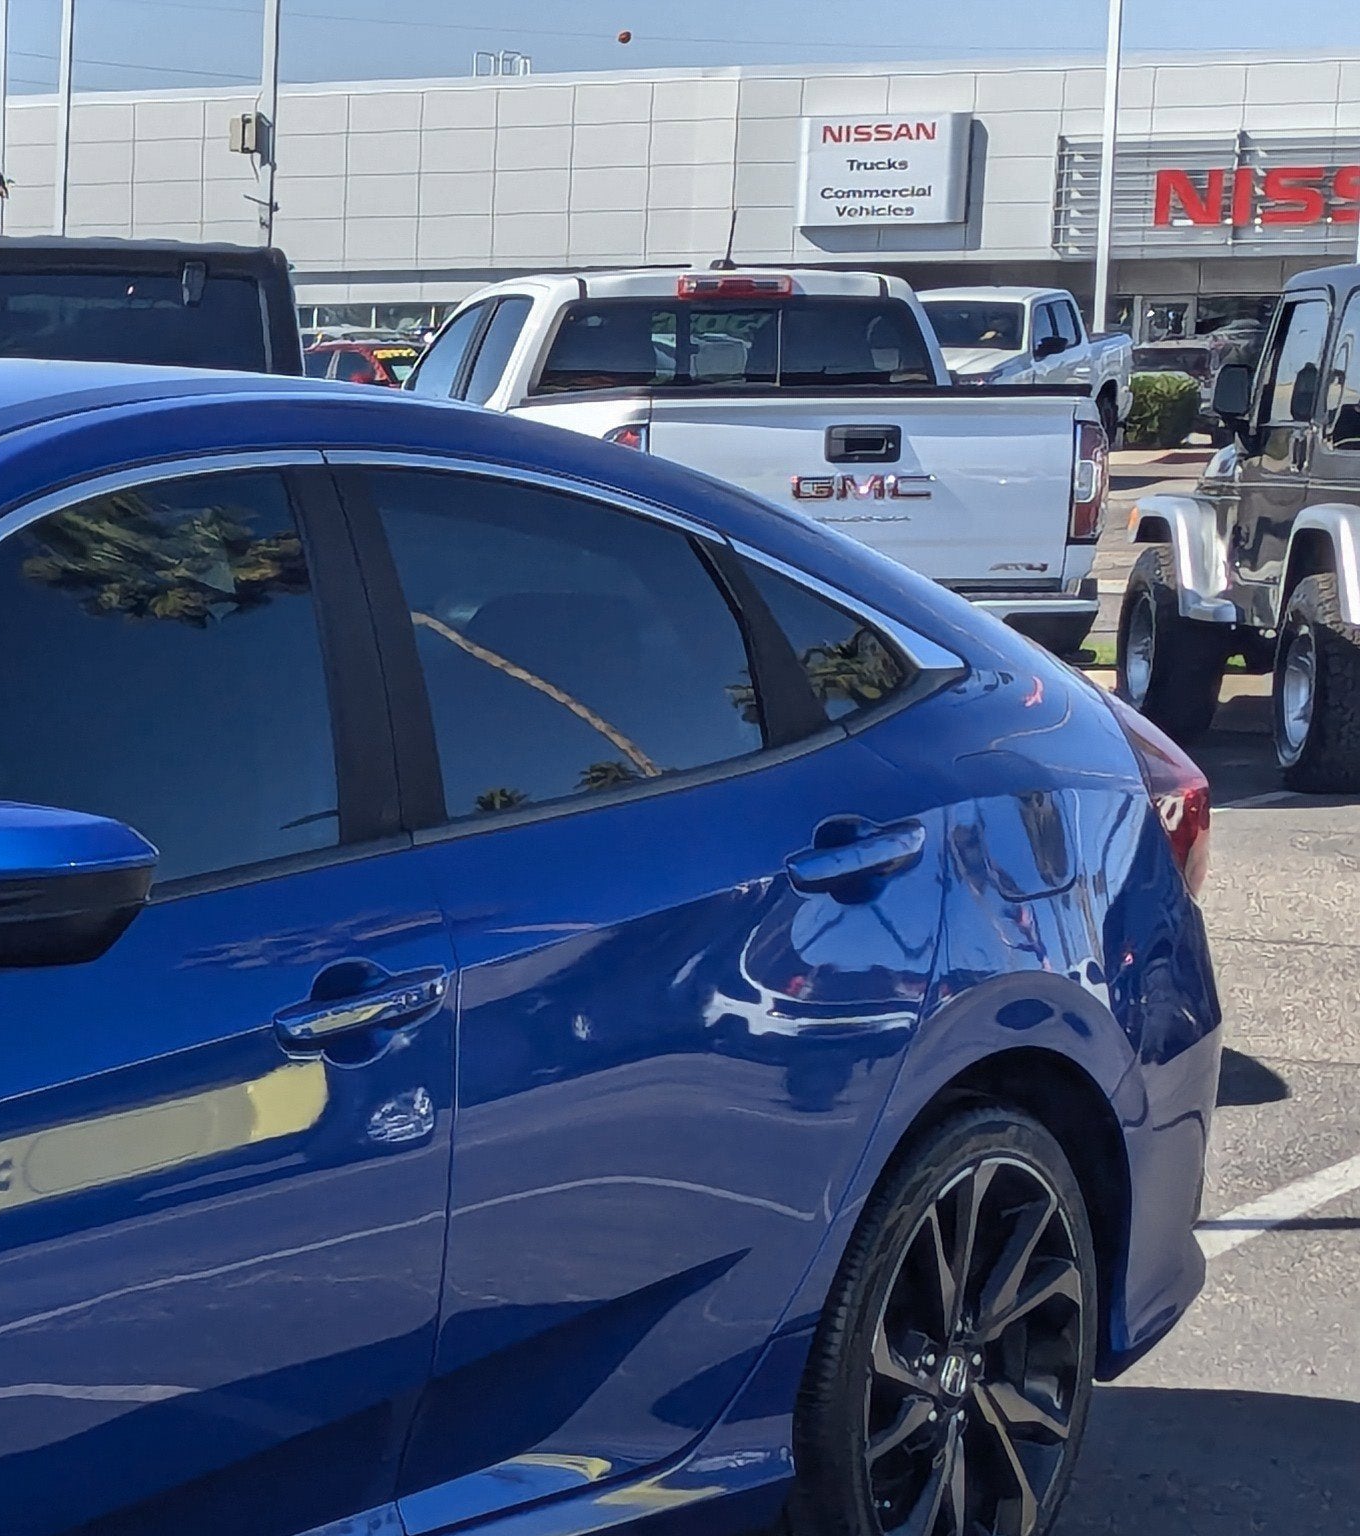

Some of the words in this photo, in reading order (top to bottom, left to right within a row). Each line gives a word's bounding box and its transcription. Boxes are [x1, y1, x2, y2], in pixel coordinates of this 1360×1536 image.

[822, 122, 936, 143] NISSAN
[847, 158, 909, 171] Trucks
[821, 185, 932, 199] Commercial
[835, 204, 914, 217] Vehicles
[791, 473, 934, 500] GMC
